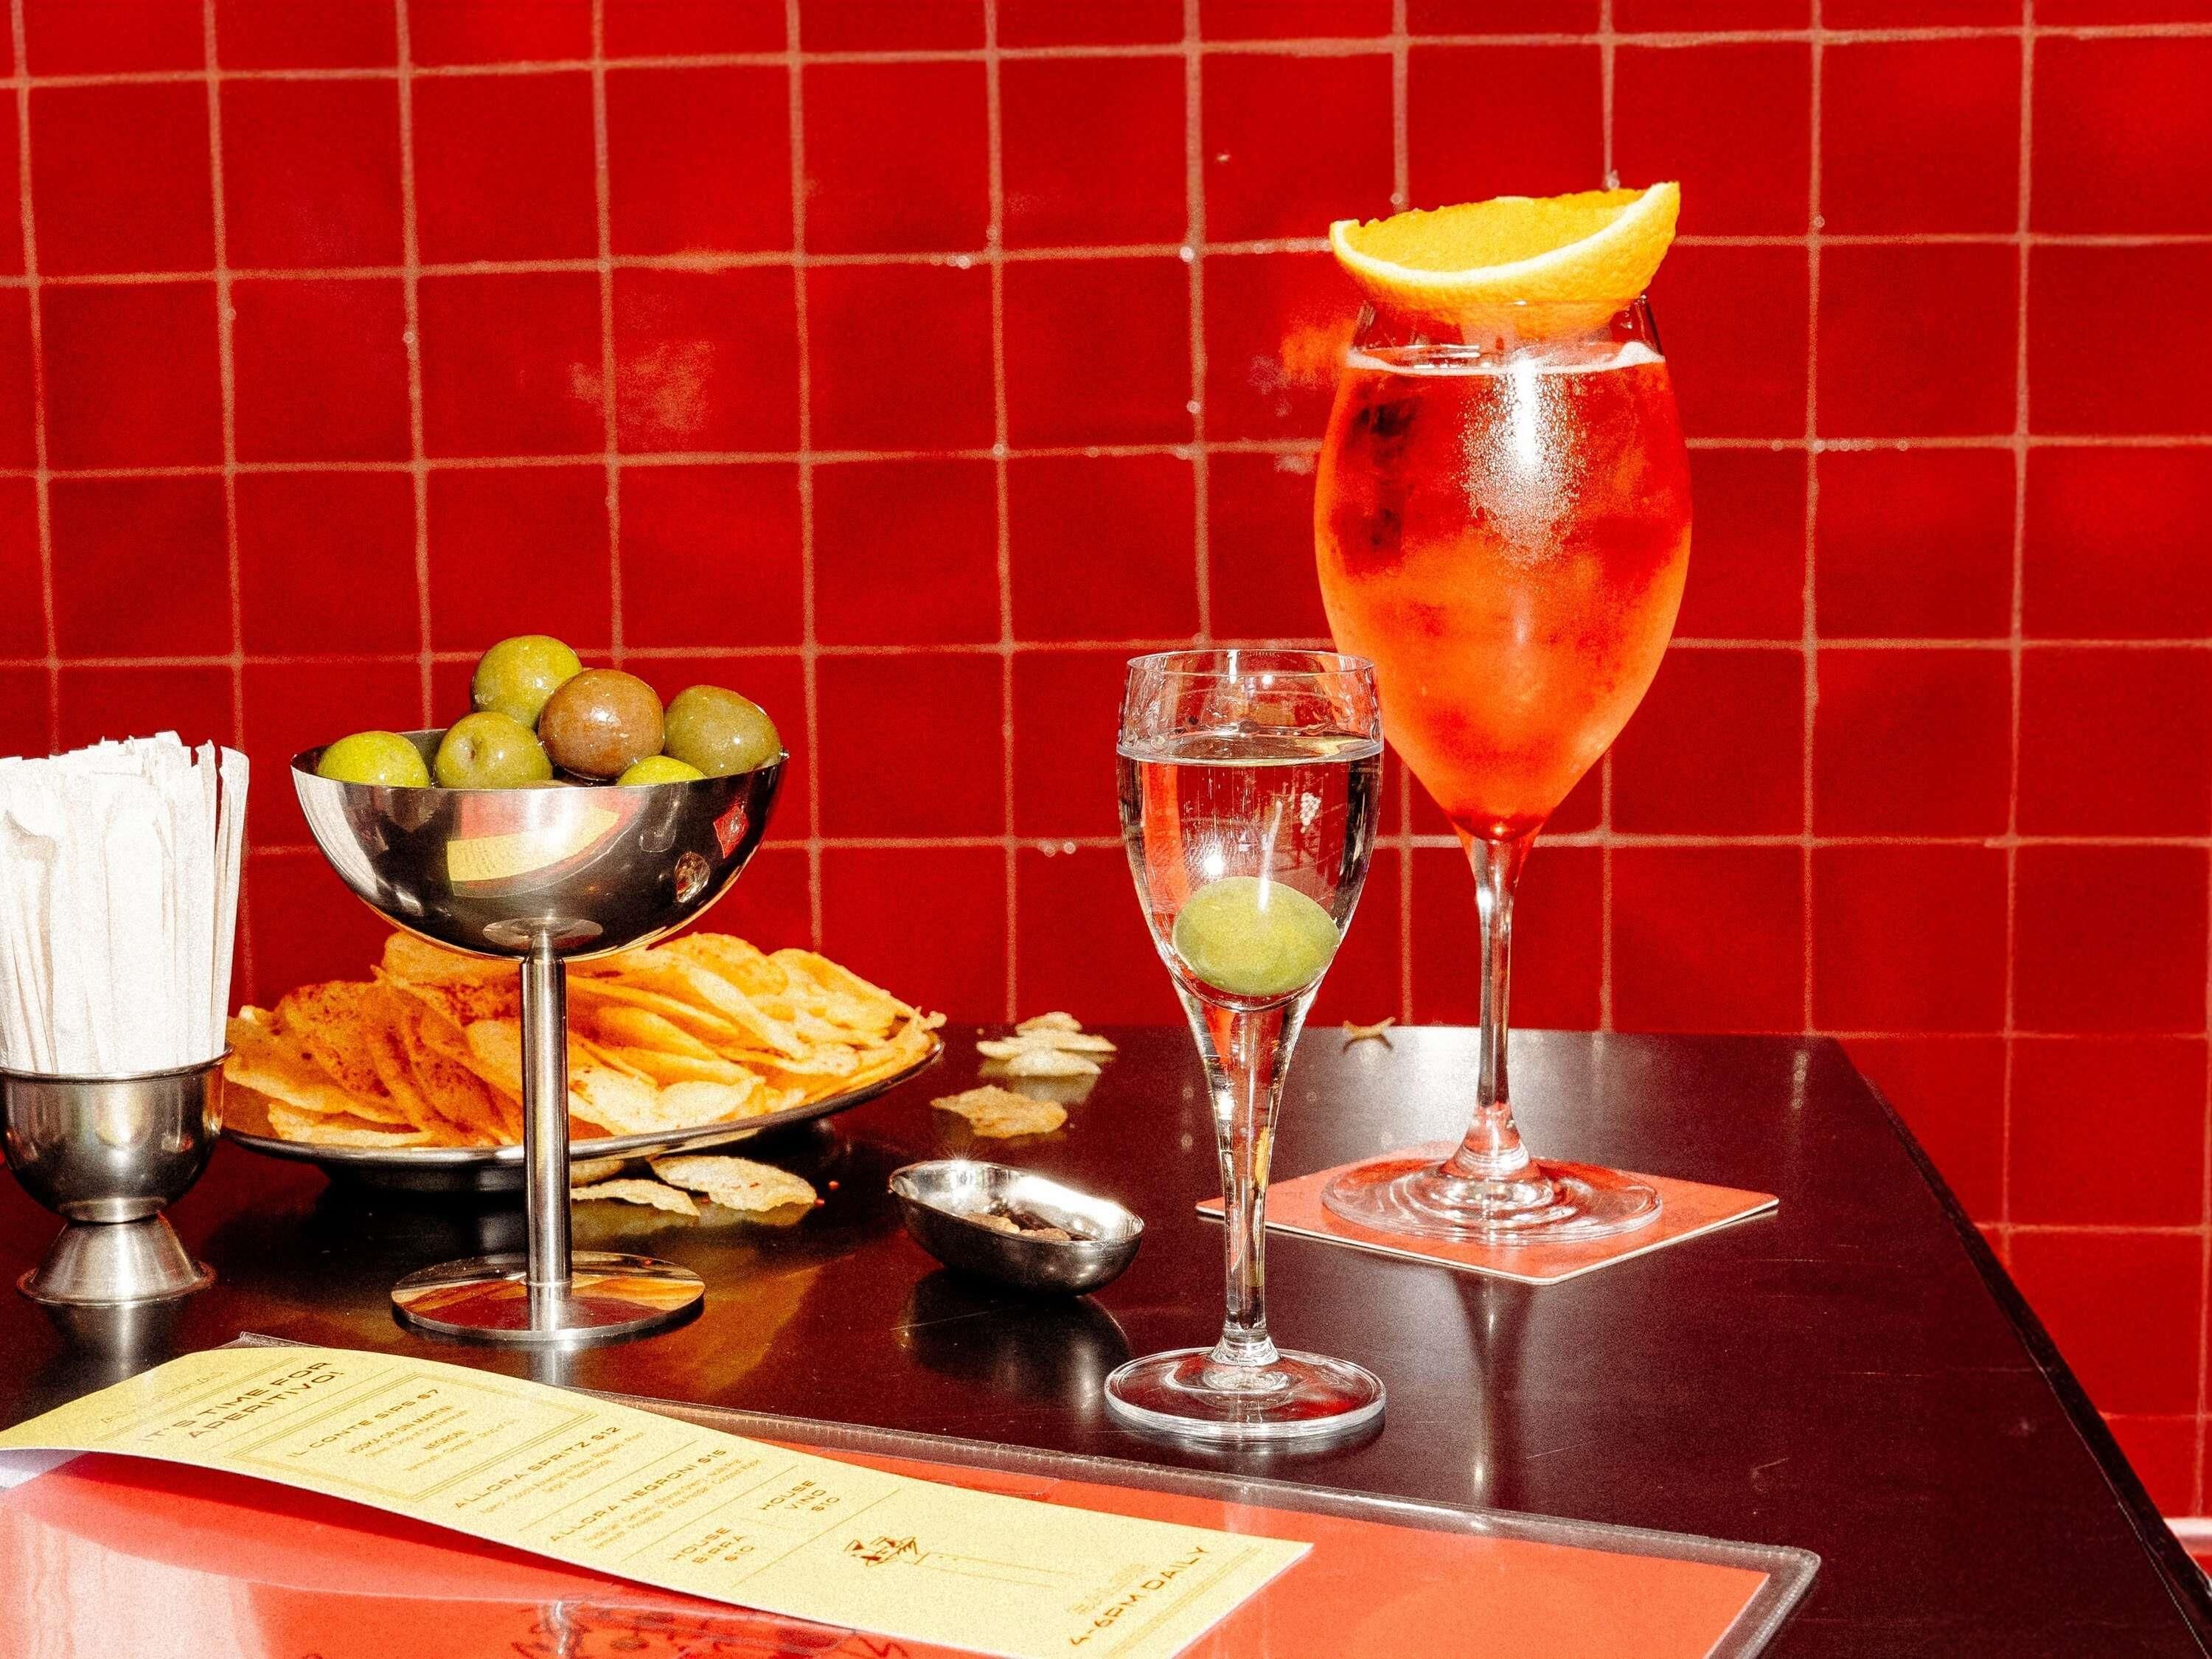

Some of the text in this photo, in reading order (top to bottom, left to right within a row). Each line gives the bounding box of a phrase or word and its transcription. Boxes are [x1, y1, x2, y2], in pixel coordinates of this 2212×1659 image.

[187, 1371, 346, 1438] APERITIVO!
[195, 1388, 271, 1416] TIME
[267, 1362, 334, 1385] FOR
[307, 1419, 375, 1448] CONTE
[372, 1399, 418, 1419] SIPS
[450, 1471, 529, 1509] ALLORA
[525, 1440, 593, 1472] SPRITZ
[588, 1425, 622, 1441] $12
[545, 1503, 622, 1542] ALLORA
[619, 1464, 700, 1503] NEGRONI
[695, 1448, 728, 1464] $15
[757, 1479, 817, 1511] HOUSE
[784, 1488, 828, 1510] VINO
[808, 1496, 842, 1512] $10
[667, 1526, 731, 1562] HOUSE
[1141, 1546, 1210, 1590] DAILY
